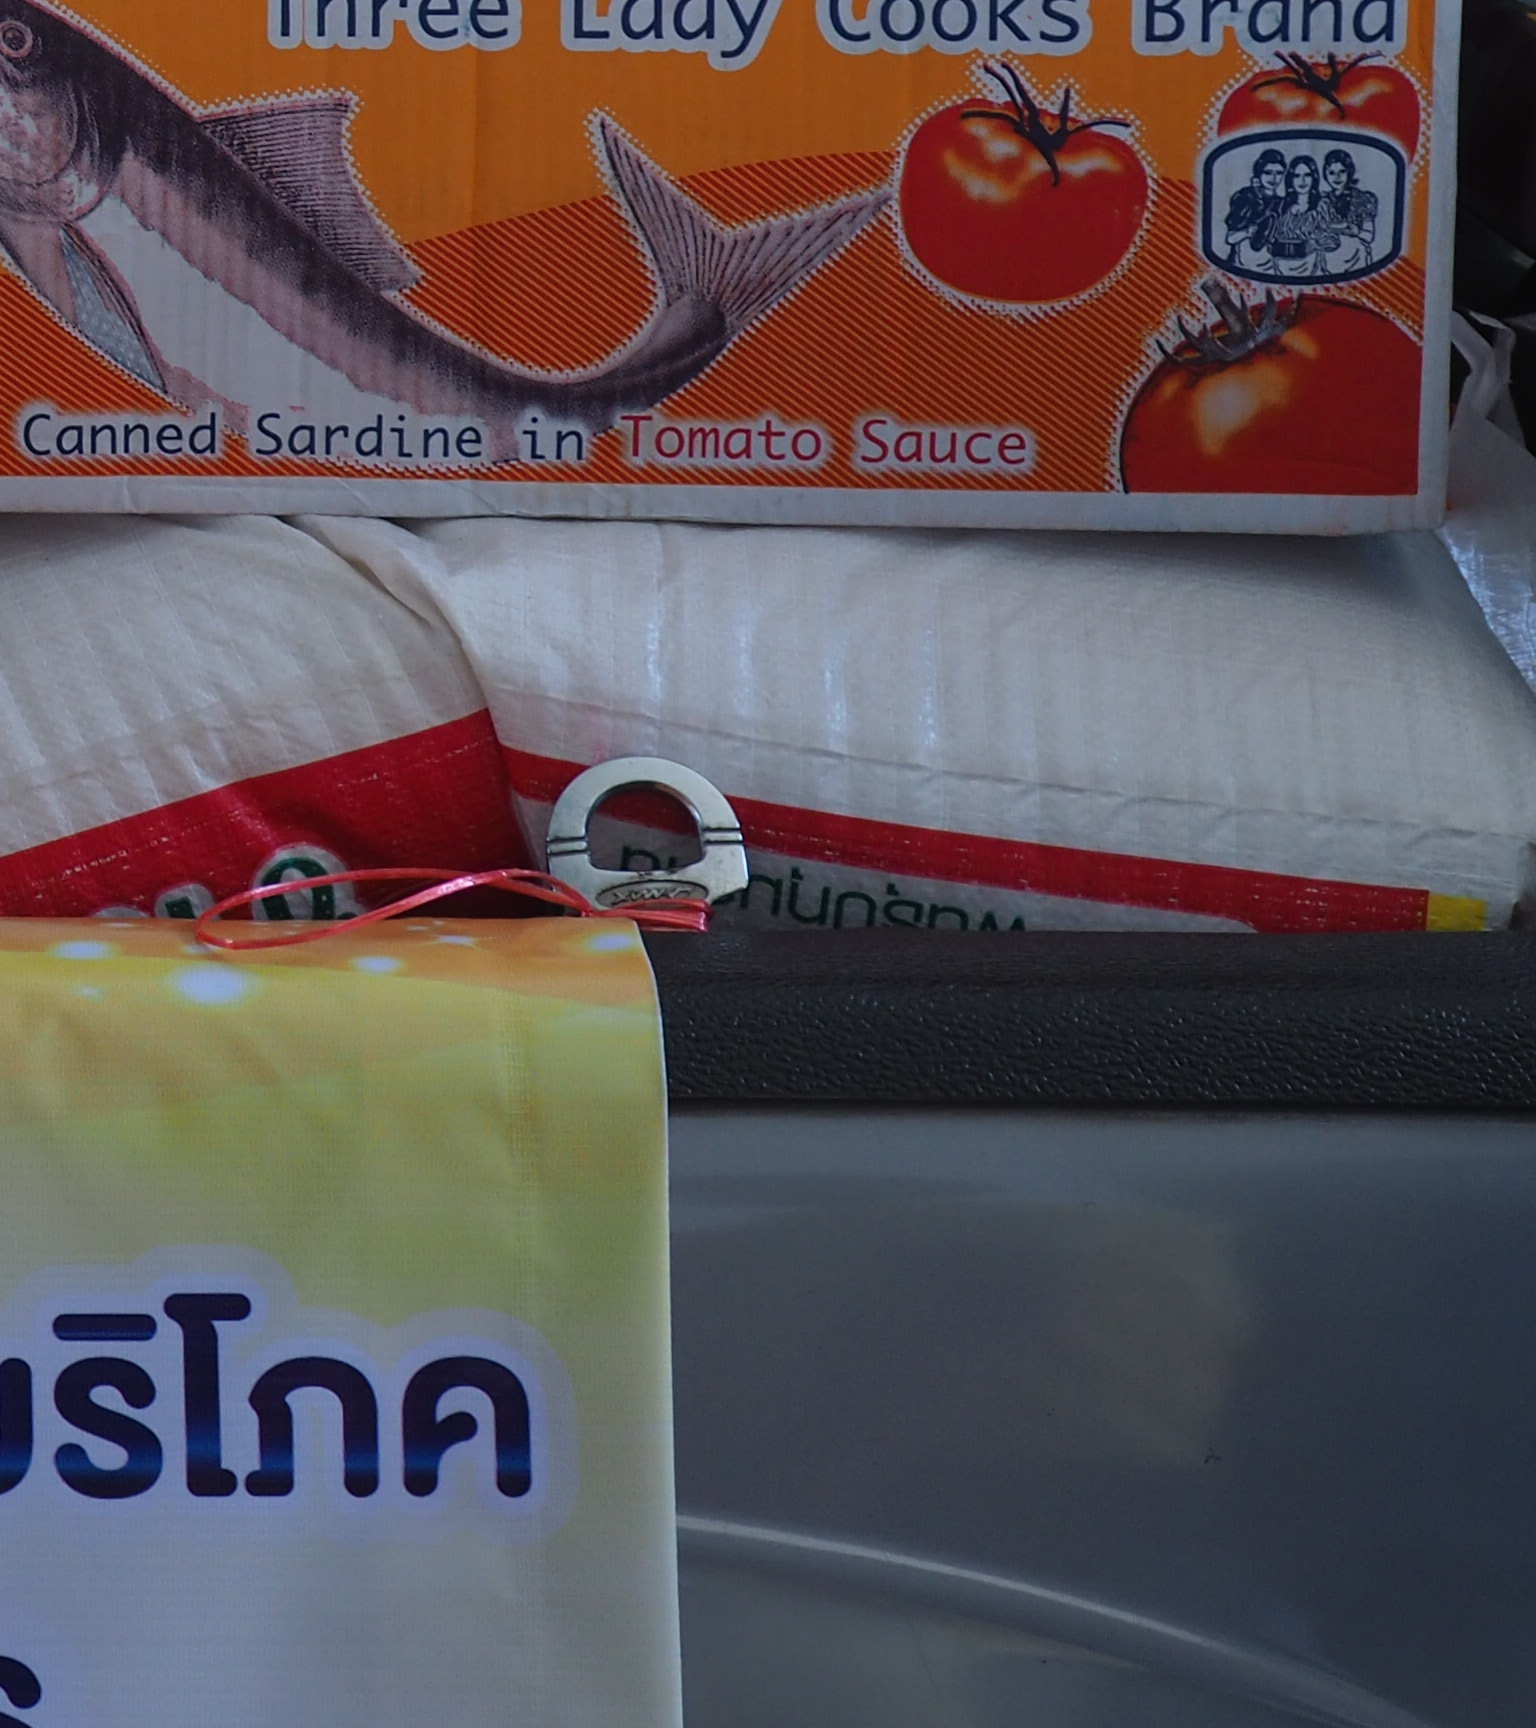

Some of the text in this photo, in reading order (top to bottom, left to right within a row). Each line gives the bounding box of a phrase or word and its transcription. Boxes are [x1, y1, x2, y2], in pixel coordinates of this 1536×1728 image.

[20, 409, 1028, 465] Canned Sardine in Tomato Sauce
